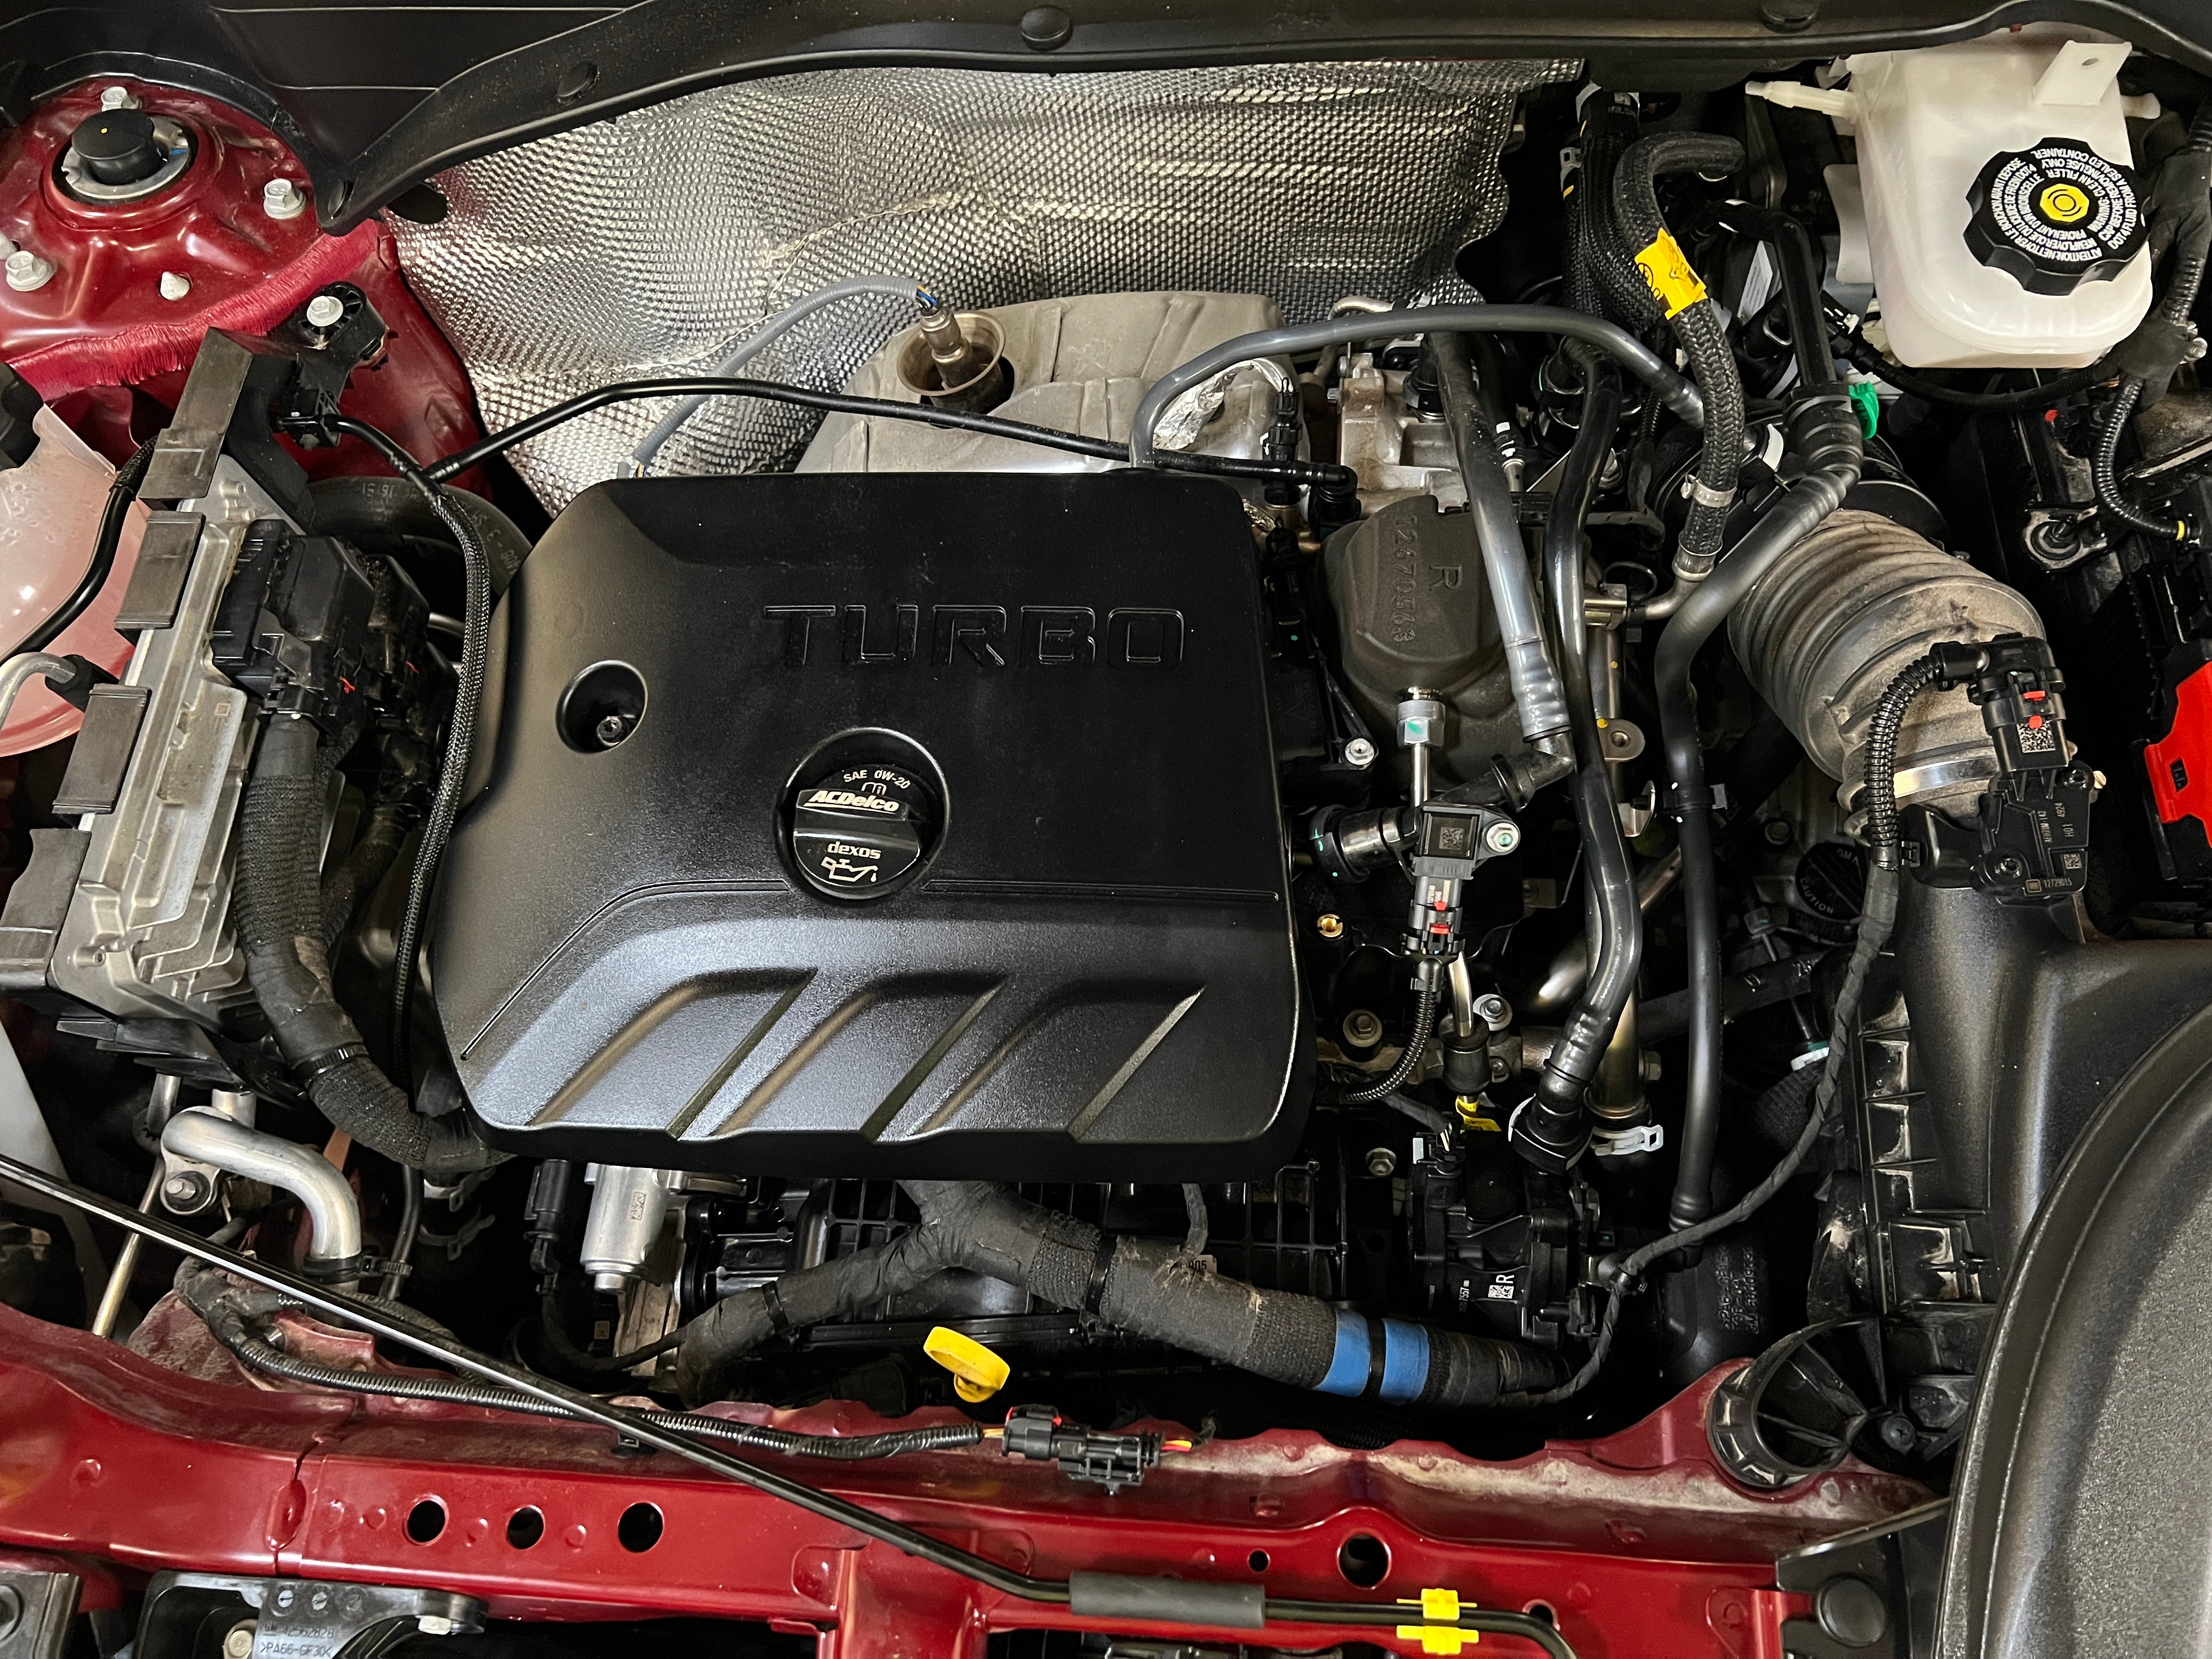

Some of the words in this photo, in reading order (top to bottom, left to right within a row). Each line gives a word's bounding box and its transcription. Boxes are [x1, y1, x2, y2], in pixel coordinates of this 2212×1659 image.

[2015, 165, 2032, 180] DOT
[2041, 157, 2066, 169] ONLY
[2065, 158, 2086, 172] USE
[2087, 156, 2122, 182] SEALED
[2045, 167, 2080, 180] FILLER
[2115, 178, 2128, 186] A
[1990, 177, 2006, 201] AVANT
[2077, 173, 2106, 197] CLEAN
[2003, 194, 2016, 204] DE
[2118, 184, 2137, 208] FROM
[1990, 199, 2013, 231] BOUCHON
[2086, 196, 2111, 233] WARNING:
[2108, 198, 2124, 228] BEFORE
[2120, 208, 2137, 232] FLUID
[2004, 227, 2019, 240] LE
[2017, 224, 2034, 236] DU
[2027, 230, 2048, 245] QUE
[2097, 224, 2116, 241] CAP
[2013, 234, 2056, 259] NETTOYER
[2107, 231, 2127, 250] DOT
[1429, 565, 1463, 591] R
[764, 605, 1185, 668] TURBO
[843, 769, 867, 783] SAE
[874, 769, 911, 789] 0W-20
[808, 790, 899, 812] ACDelco
[2055, 803, 2066, 817] 4924
[827, 841, 882, 859] dexos
[1800, 878, 1835, 915] CAUTION
[1496, 1274, 1515, 1284] R
